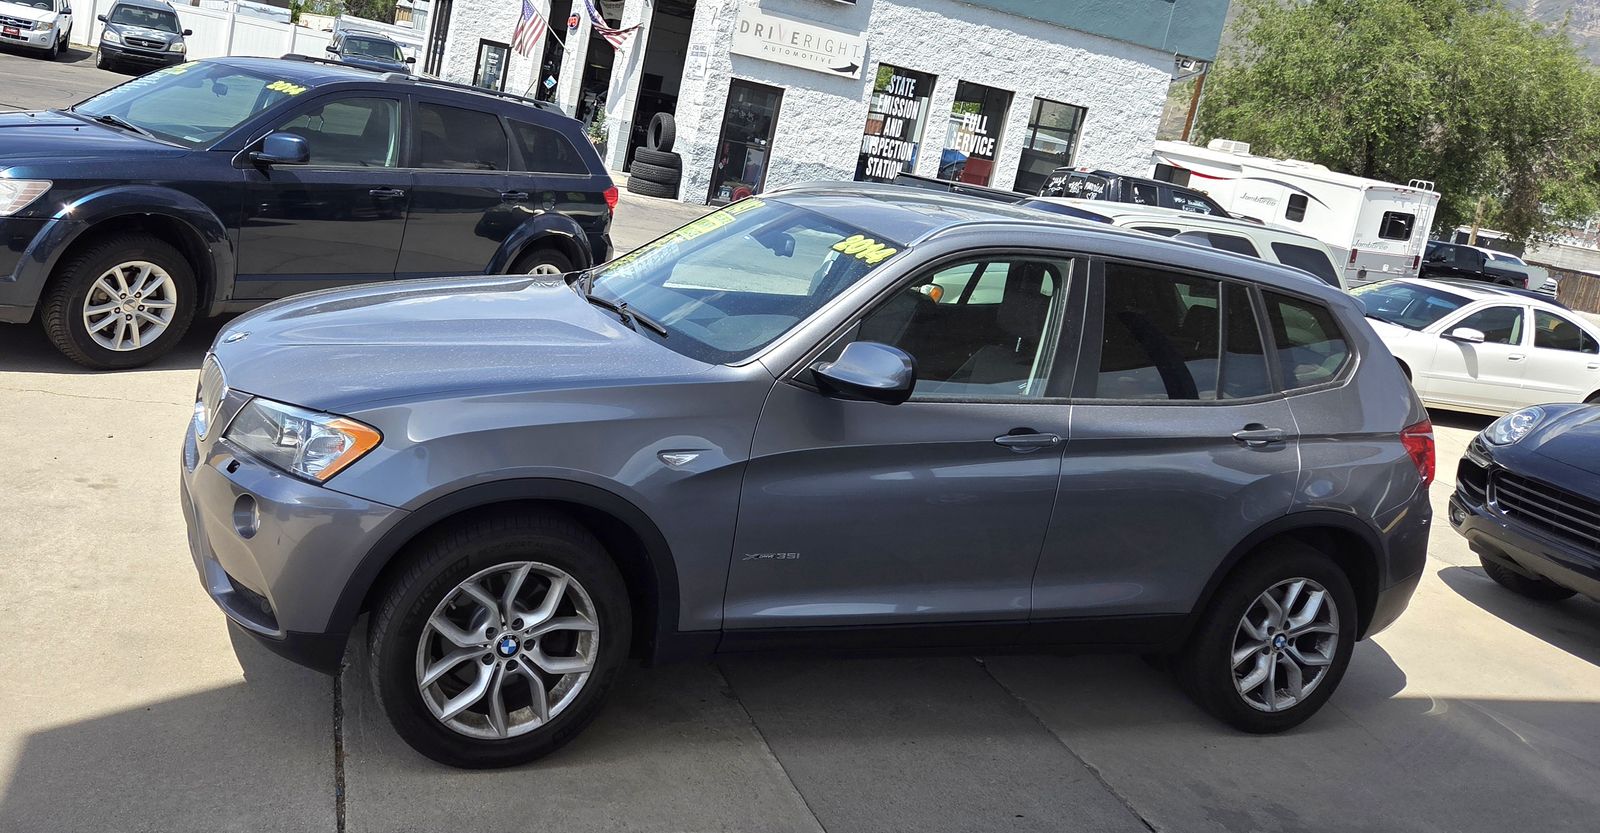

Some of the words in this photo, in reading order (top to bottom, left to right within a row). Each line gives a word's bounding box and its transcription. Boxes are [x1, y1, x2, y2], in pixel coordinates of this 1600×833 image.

[740, 19, 860, 58] DRIVERIGHT
[764, 44, 832, 64] AUTOMOTIVE
[889, 74, 917, 98] STATE
[877, 93, 920, 119] EMISSION
[883, 116, 904, 138] AND
[961, 112, 988, 135] FULL
[861, 135, 915, 161] INSPECTION
[950, 131, 995, 156] SERVICE
[865, 156, 904, 180] STATION
[832, 234, 898, 264] 2014
